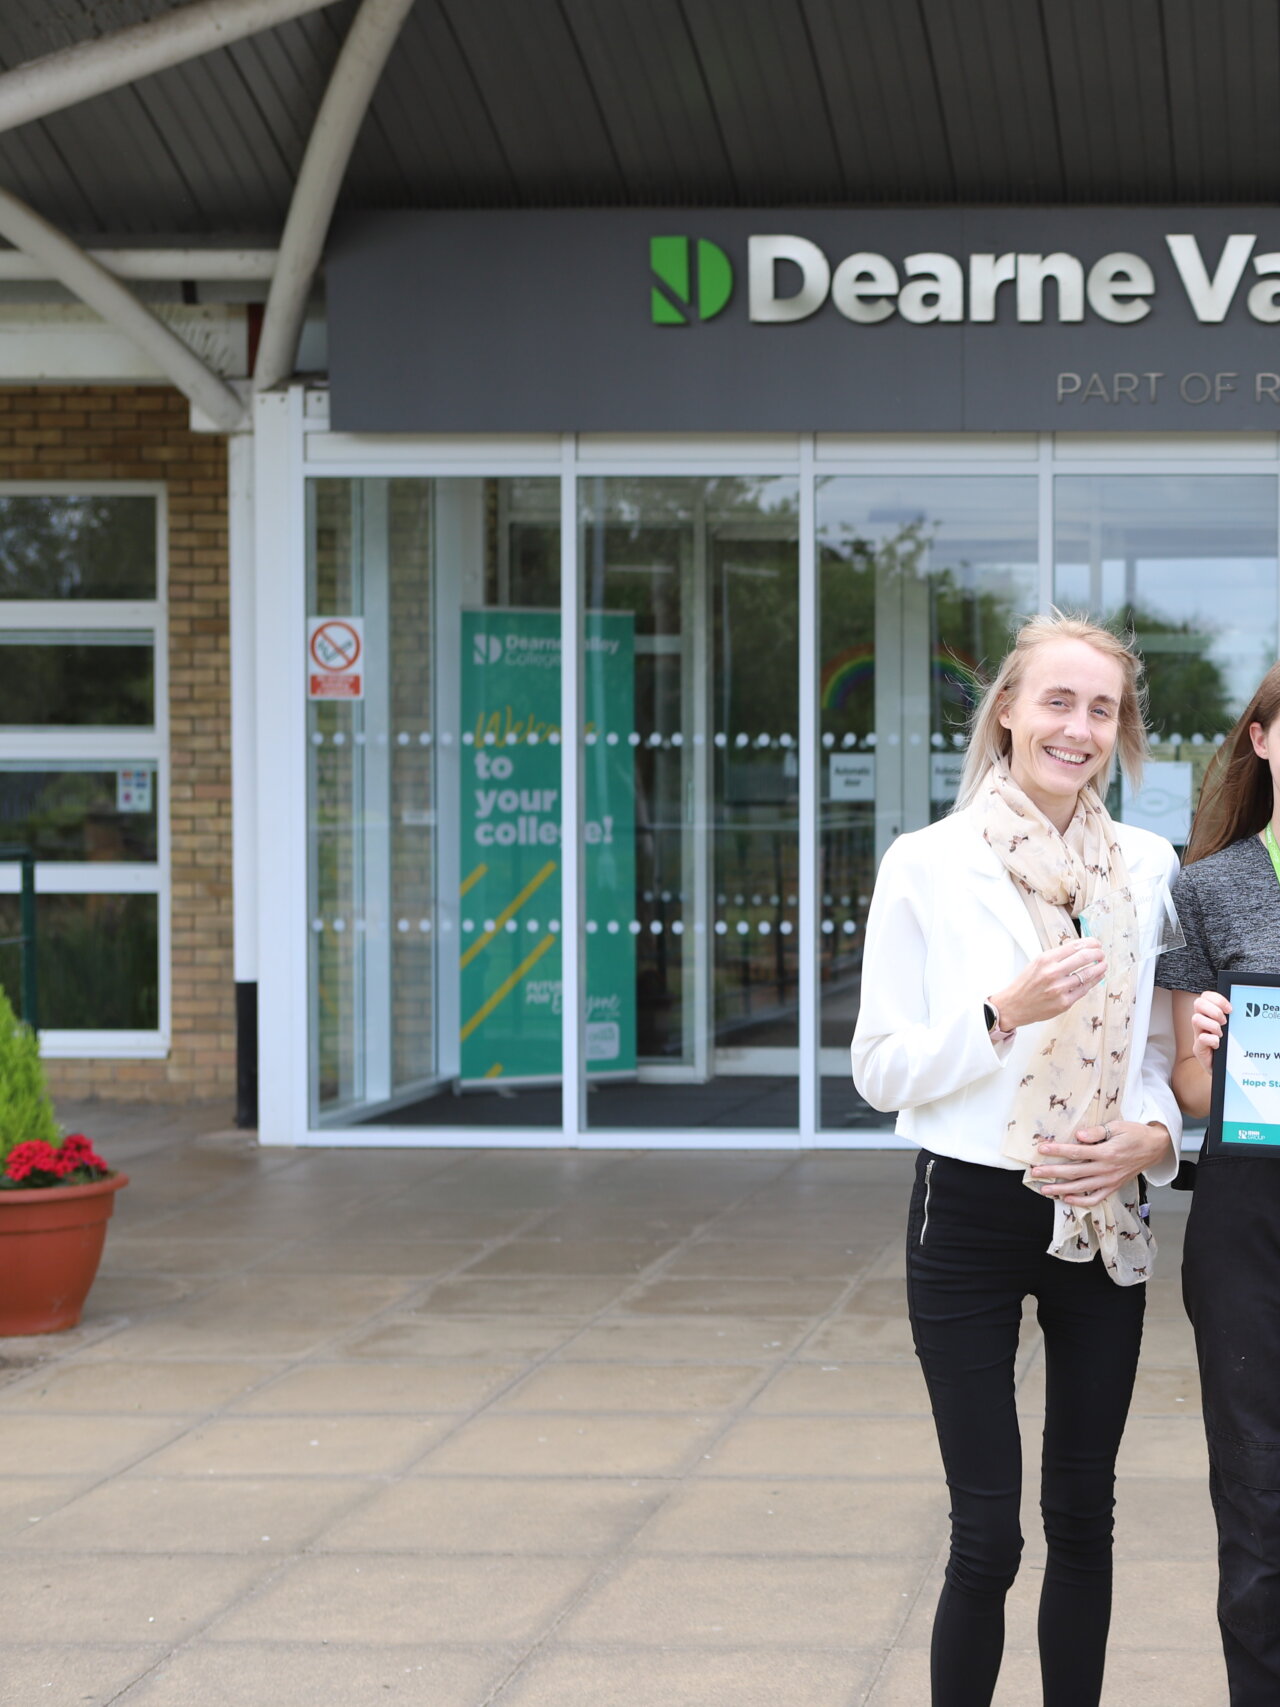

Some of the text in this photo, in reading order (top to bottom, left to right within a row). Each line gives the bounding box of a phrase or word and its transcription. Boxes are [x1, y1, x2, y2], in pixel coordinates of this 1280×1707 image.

[748, 234, 1155, 324] Dearne
[1056, 371, 1166, 404] PART
[1179, 371, 1239, 405] OF
[474, 751, 514, 780] to
[474, 788, 558, 819] your
[474, 815, 613, 847] collee!
[1243, 1050, 1271, 1060] Jenny
[1242, 1078, 1267, 1088] Hope
